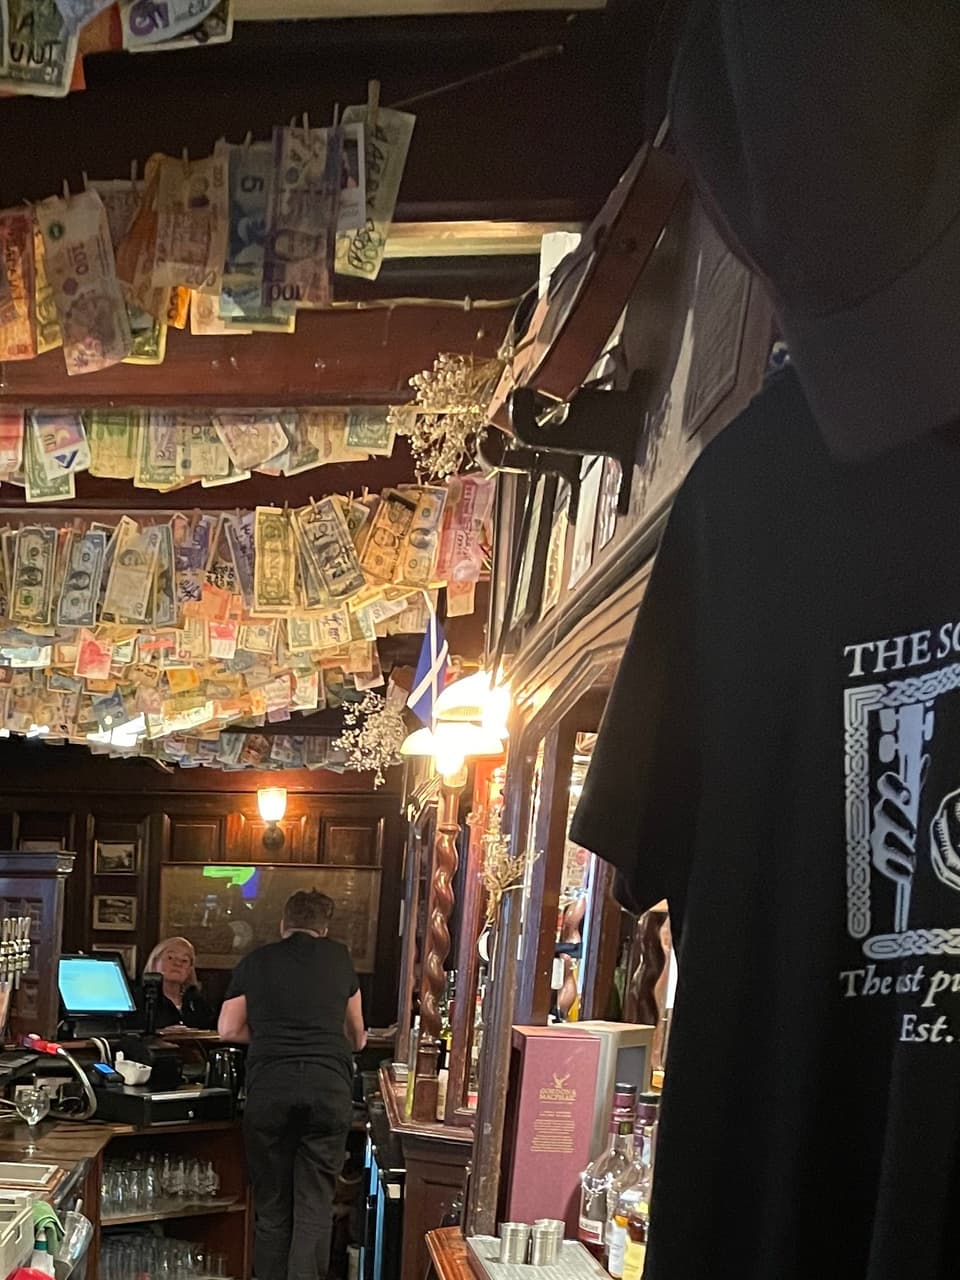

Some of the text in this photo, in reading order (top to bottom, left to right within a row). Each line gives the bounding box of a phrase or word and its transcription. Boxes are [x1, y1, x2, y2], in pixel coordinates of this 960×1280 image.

[843, 629, 932, 677] THE
[839, 964, 893, 998] The
[899, 1013, 954, 1043] Est.
